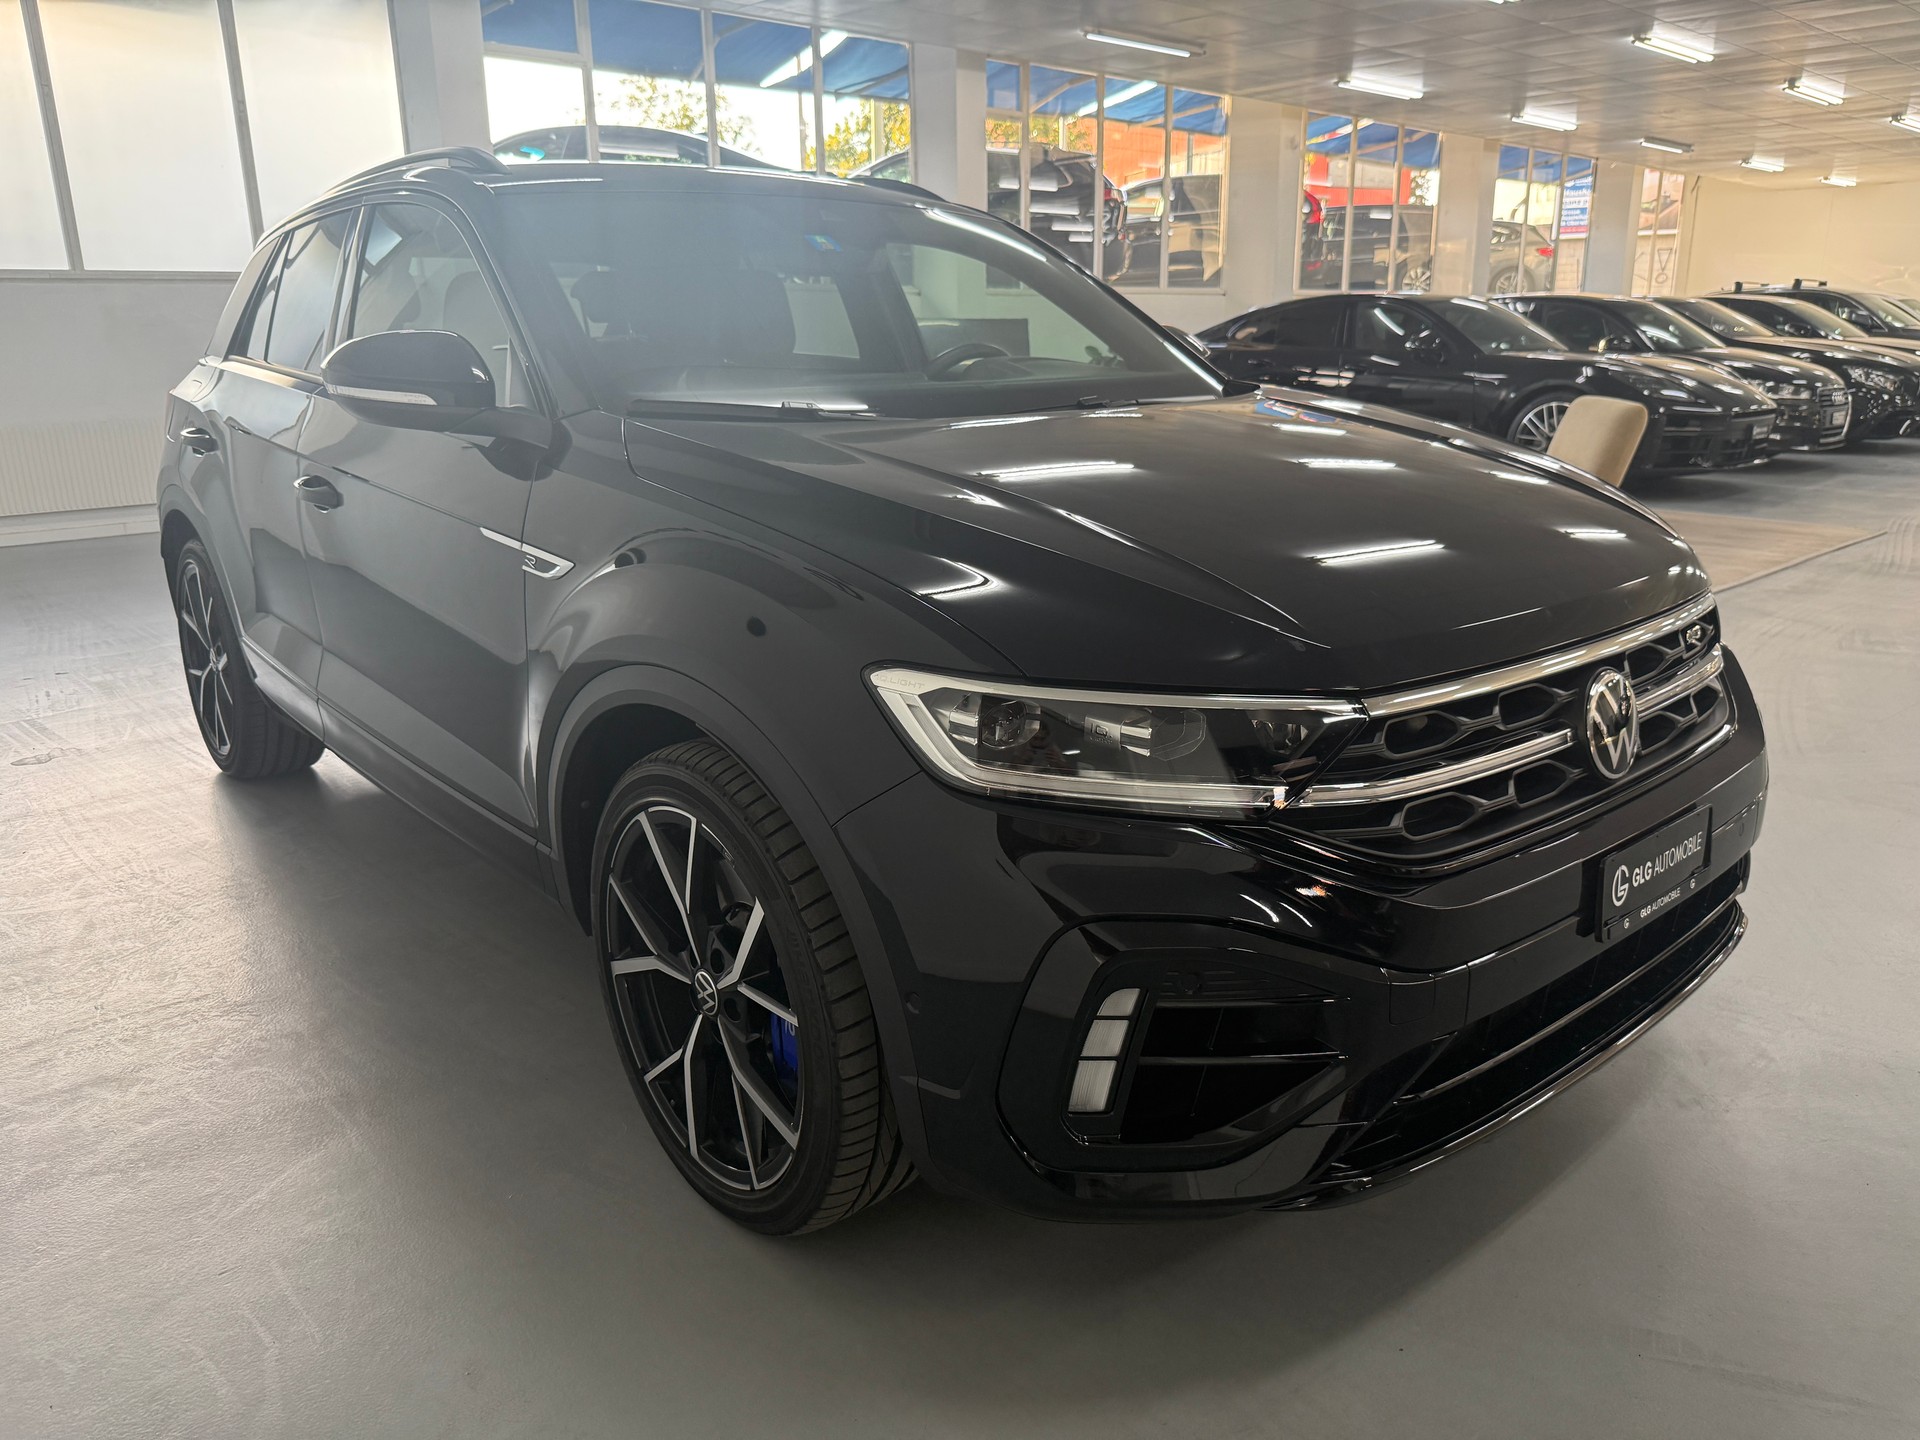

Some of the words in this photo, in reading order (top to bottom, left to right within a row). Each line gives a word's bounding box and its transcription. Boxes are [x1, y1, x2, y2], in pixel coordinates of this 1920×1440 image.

[1632, 861, 1653, 888] GLG
[1653, 831, 1703, 877] AUTOMOBILE
[1640, 905, 1652, 918] GLG
[1652, 887, 1681, 911] AUTOMOBILE
